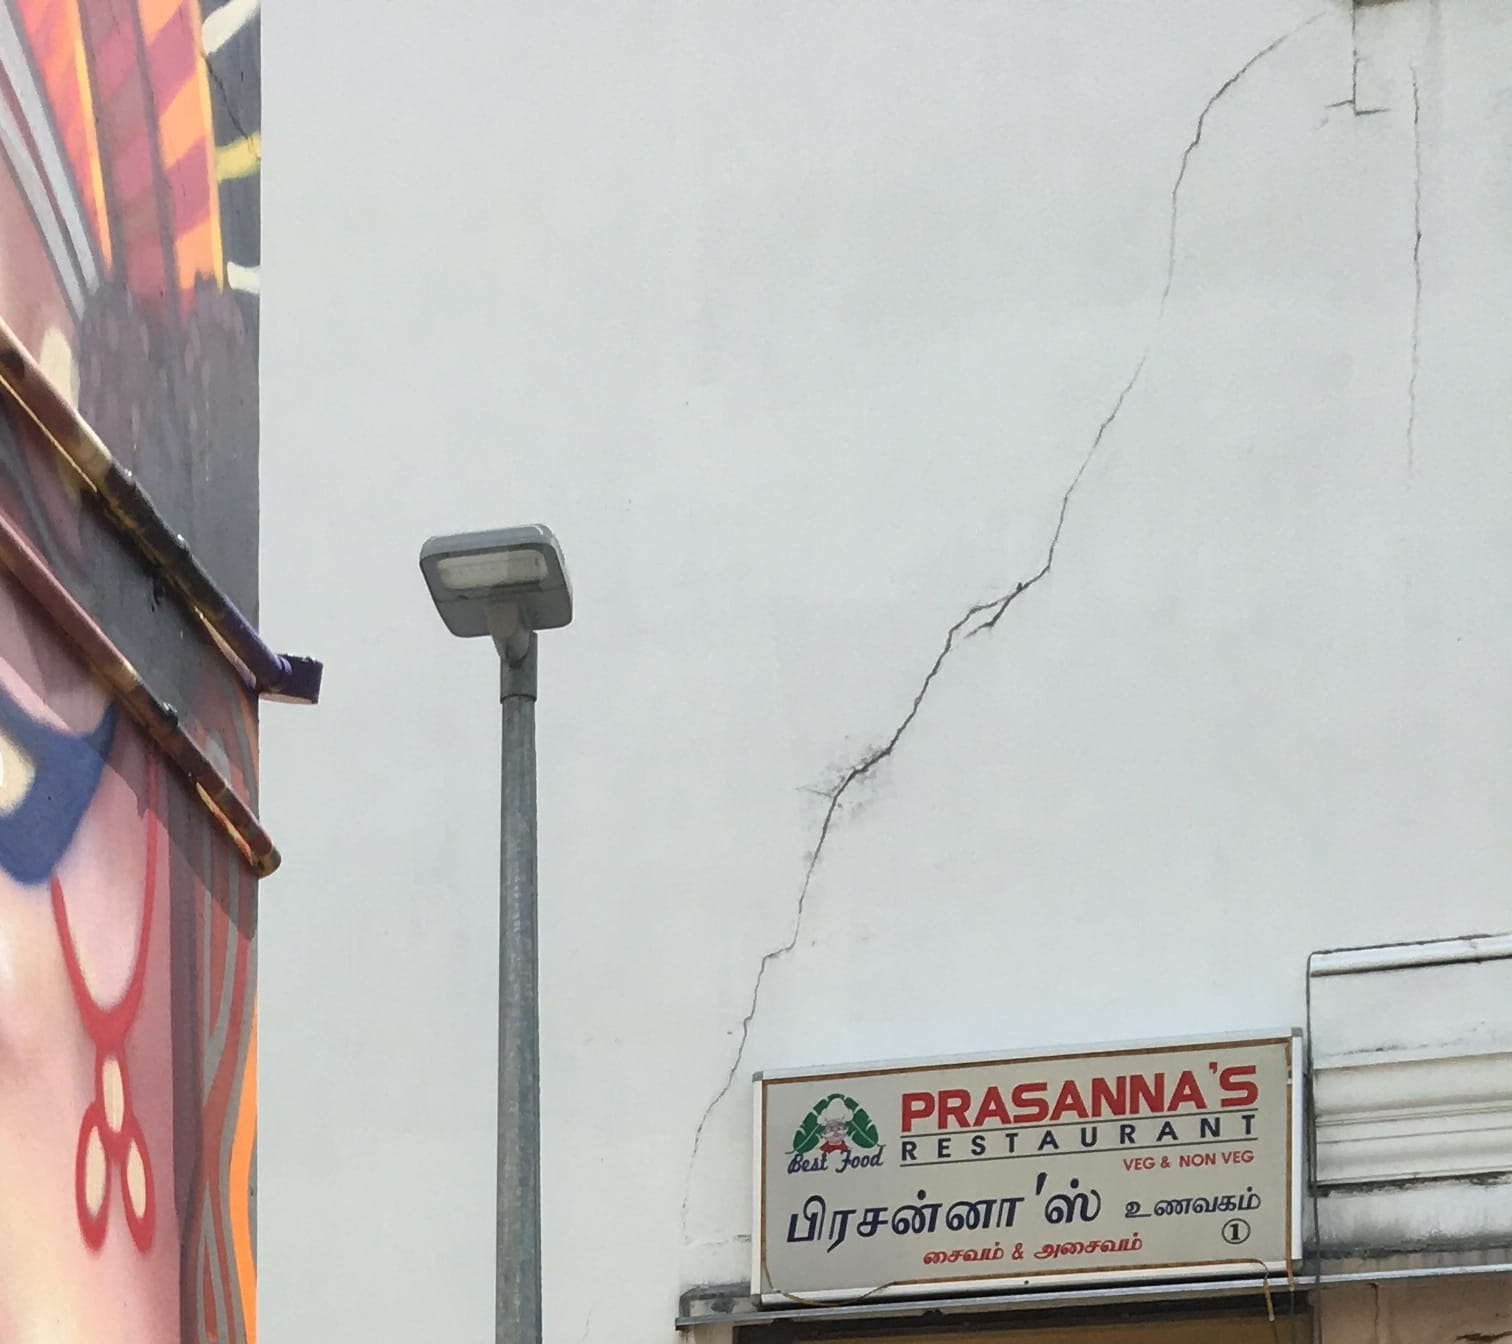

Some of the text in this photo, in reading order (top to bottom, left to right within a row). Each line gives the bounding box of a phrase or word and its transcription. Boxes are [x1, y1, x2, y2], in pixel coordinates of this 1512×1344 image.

[900, 1061, 1259, 1133] PRASANNA'S
[901, 1114, 1258, 1161] RESTAURANT
[787, 1144, 885, 1175] Best Food
[1123, 1150, 1255, 1172] VEG & NON VEG
[1124, 1185, 1262, 1219] உணவகம்
[922, 1240, 1005, 1266] சைவம்
[1012, 1243, 1026, 1261] &
